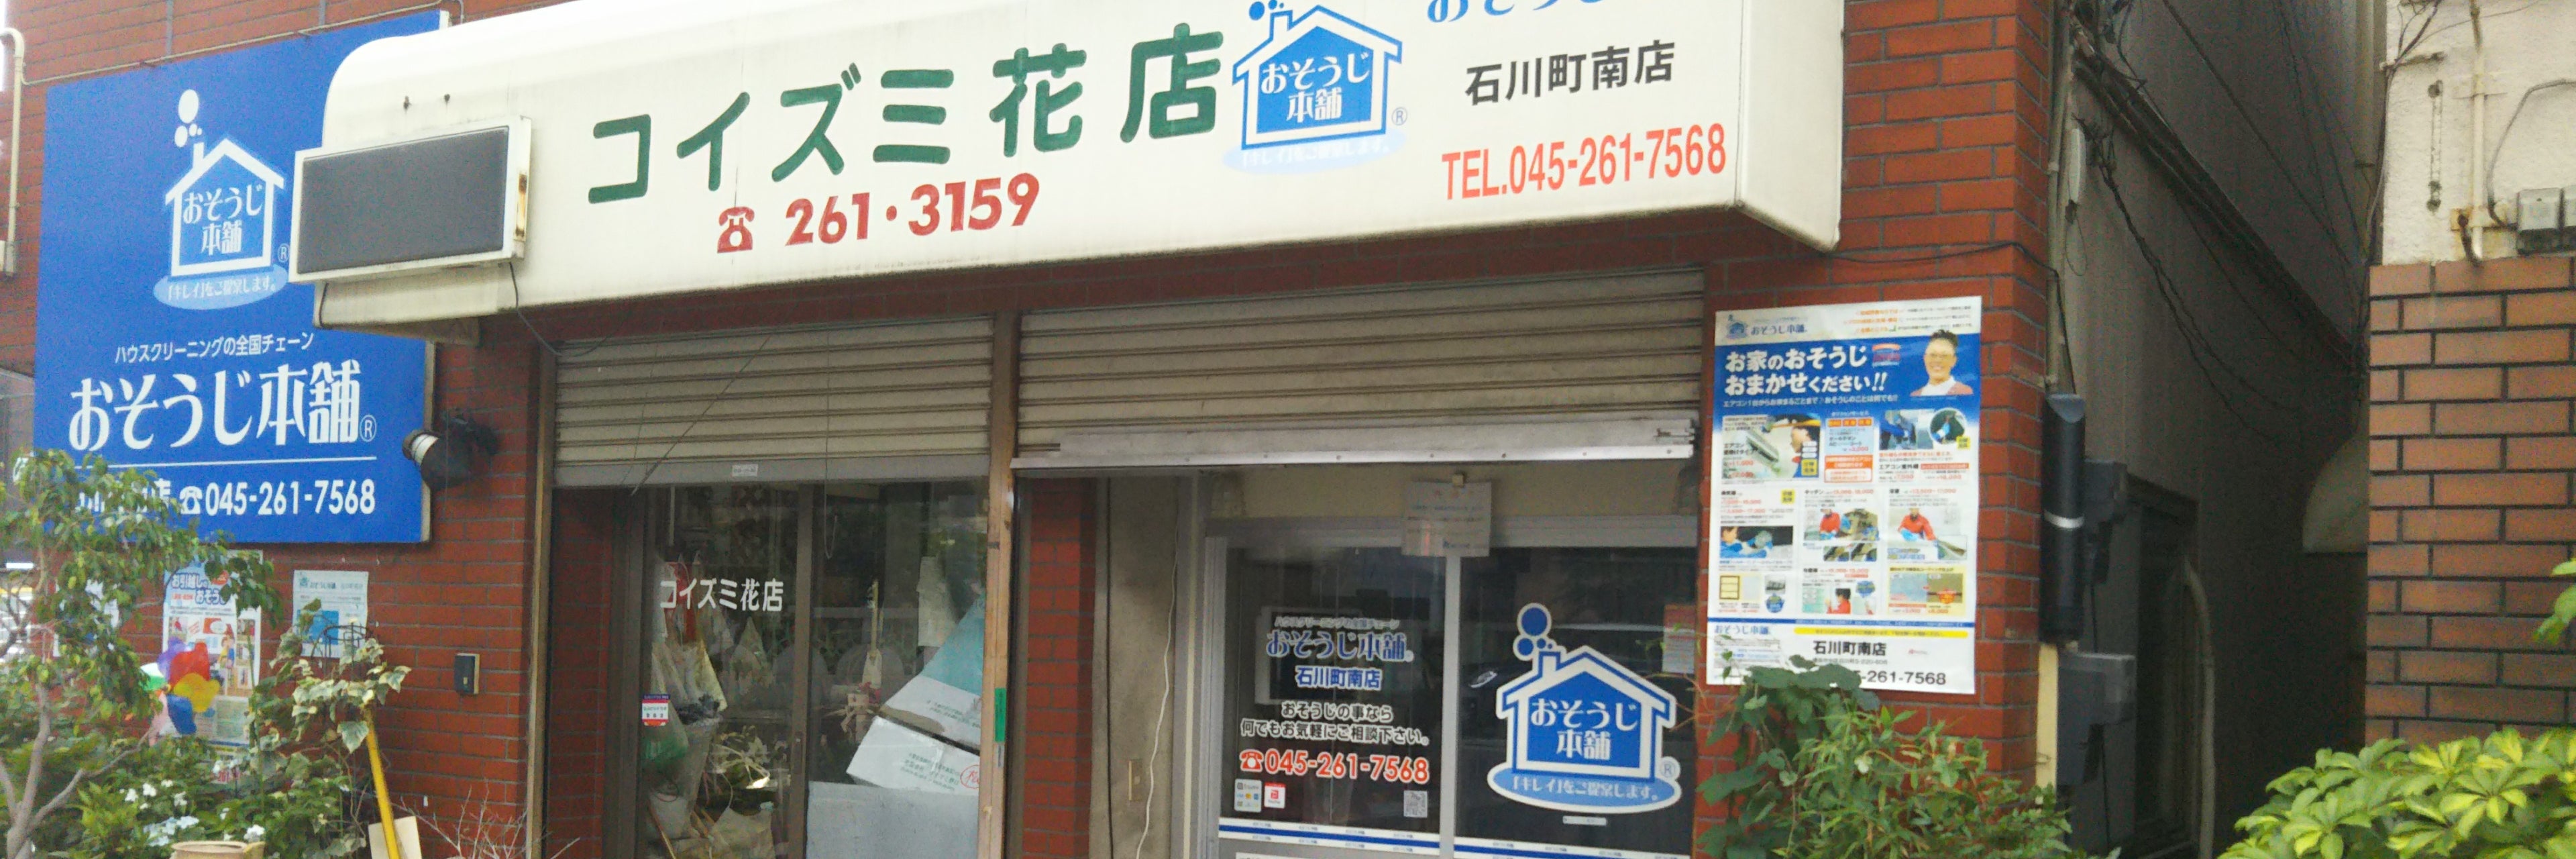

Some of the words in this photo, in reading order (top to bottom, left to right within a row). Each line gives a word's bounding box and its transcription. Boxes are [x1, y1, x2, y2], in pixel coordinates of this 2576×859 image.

[1260, 52, 1370, 94] おそうじ
[1465, 40, 1675, 106] 石川町南店
[588, 23, 1223, 205] コイズミ花店
[1286, 88, 1343, 124] 本舗
[1442, 123, 1727, 200] TEL.045-261-7568
[182, 183, 264, 225] おそうじ
[201, 219, 243, 256] 本舗
[114, 332, 315, 364] ハウスクリーニングの全国チェーン
[1725, 345, 1868, 372] お家のおそうじ
[68, 359, 362, 451] おそうじ本舗
[205, 478, 376, 516] 045-261-7568
[195, 587, 229, 605] おそう
[659, 577, 784, 612] コイズミ花店
[1266, 629, 1407, 661] おそうじ本舗
[1813, 640, 1887, 656] 石川町南店
[1295, 664, 1382, 691] 石川町南店
[1281, 701, 1394, 723] おそうじの事なら
[1530, 698, 1638, 731] おそうじ
[1556, 729, 1611, 760] 本舗
[1265, 749, 1430, 784] 045-261-7568
